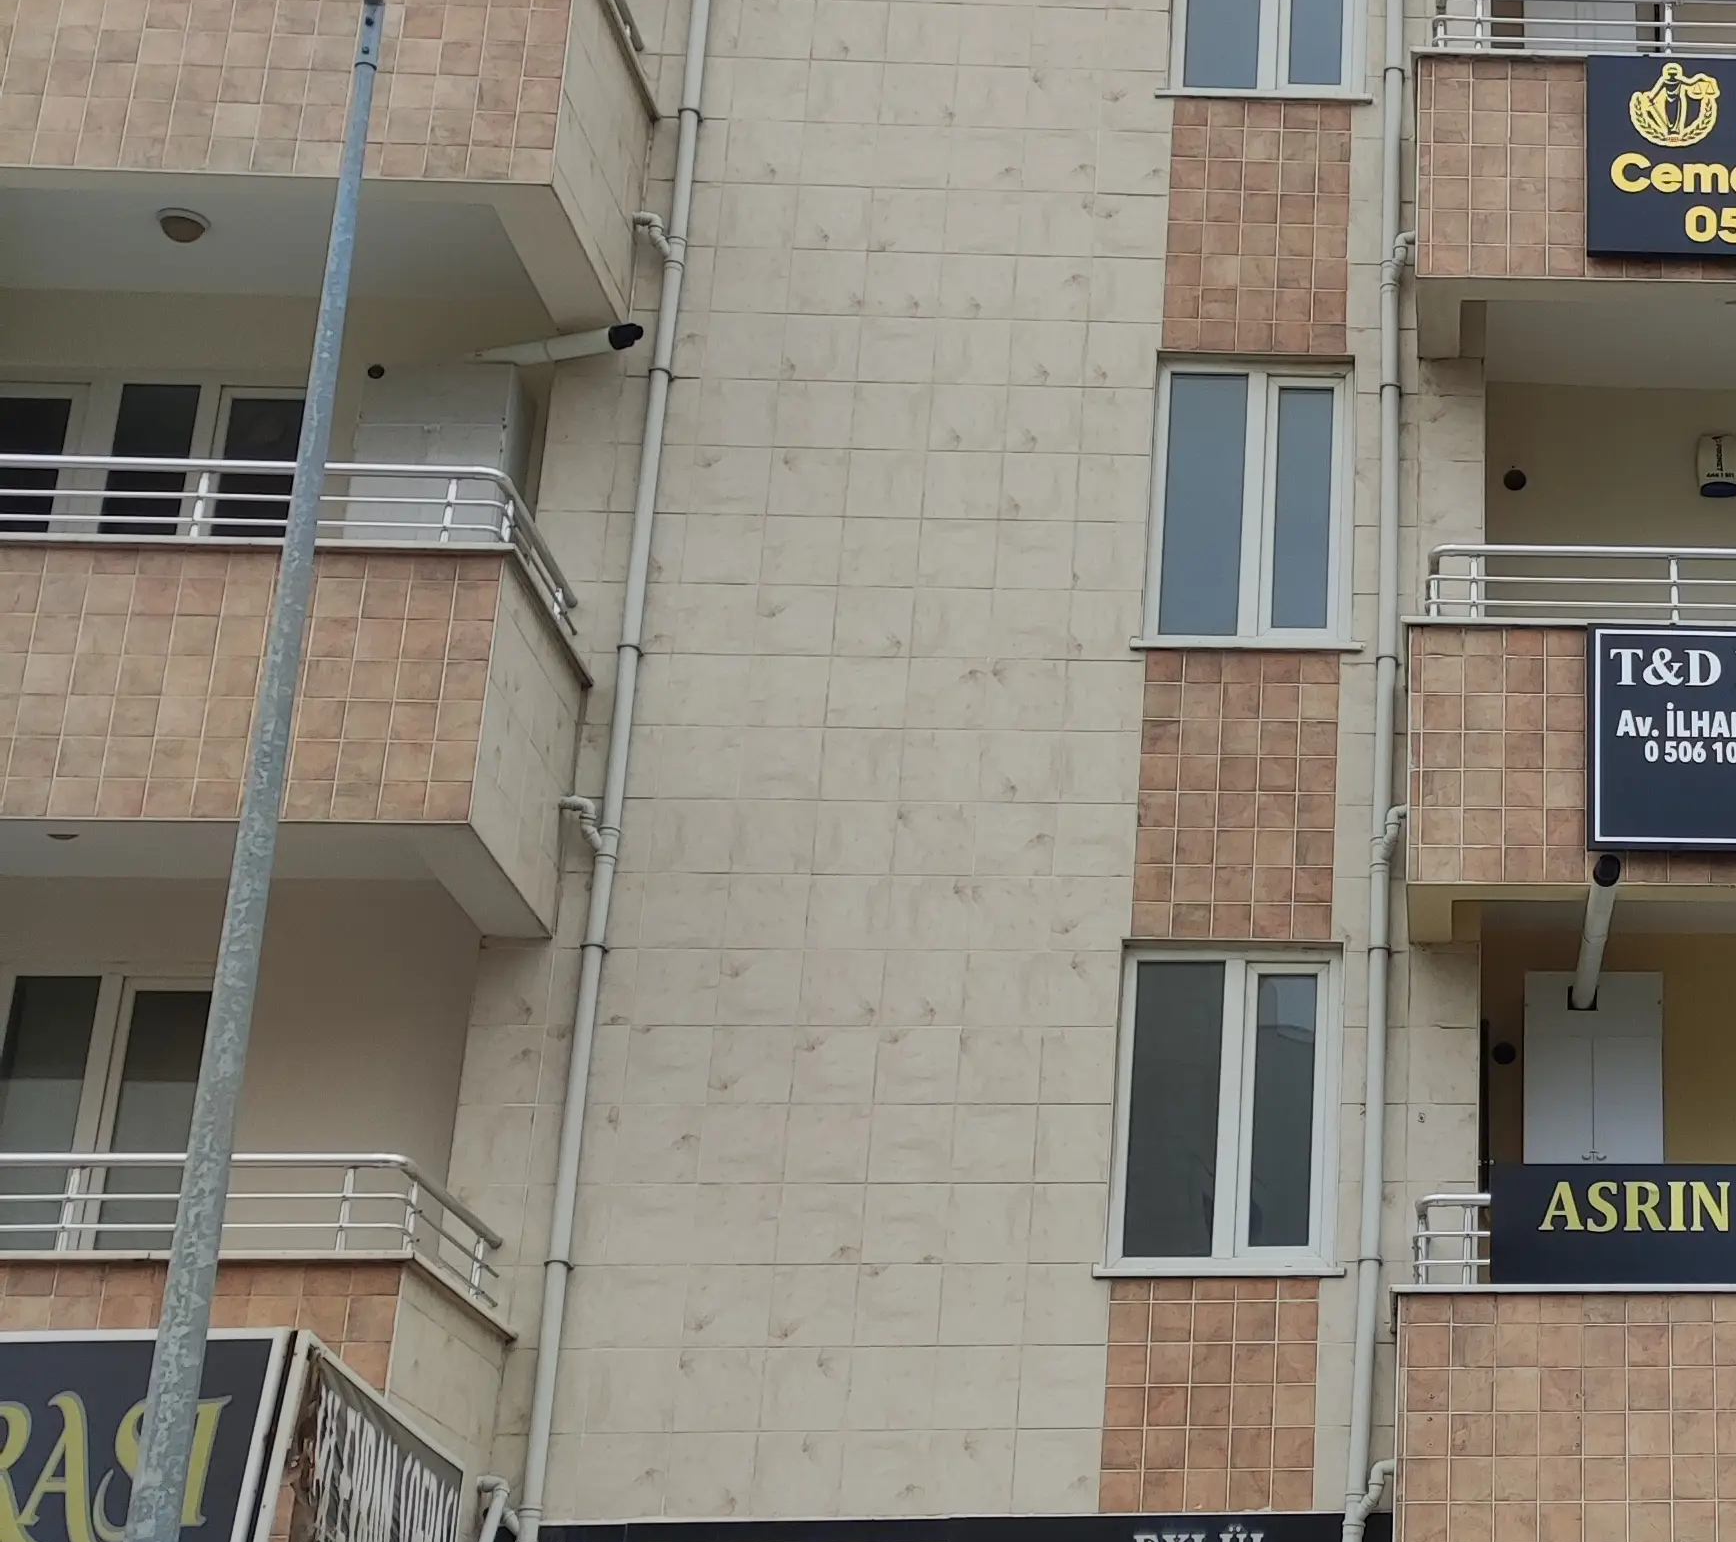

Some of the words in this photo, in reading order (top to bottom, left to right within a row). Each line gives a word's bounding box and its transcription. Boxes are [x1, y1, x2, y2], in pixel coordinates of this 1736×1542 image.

[1610, 647, 1721, 687] T&D
[1616, 710, 1660, 738] Av.
[1644, 741, 1658, 762] 0
[1664, 741, 1706, 763] 506
[1538, 1180, 1730, 1233] ASRIN
